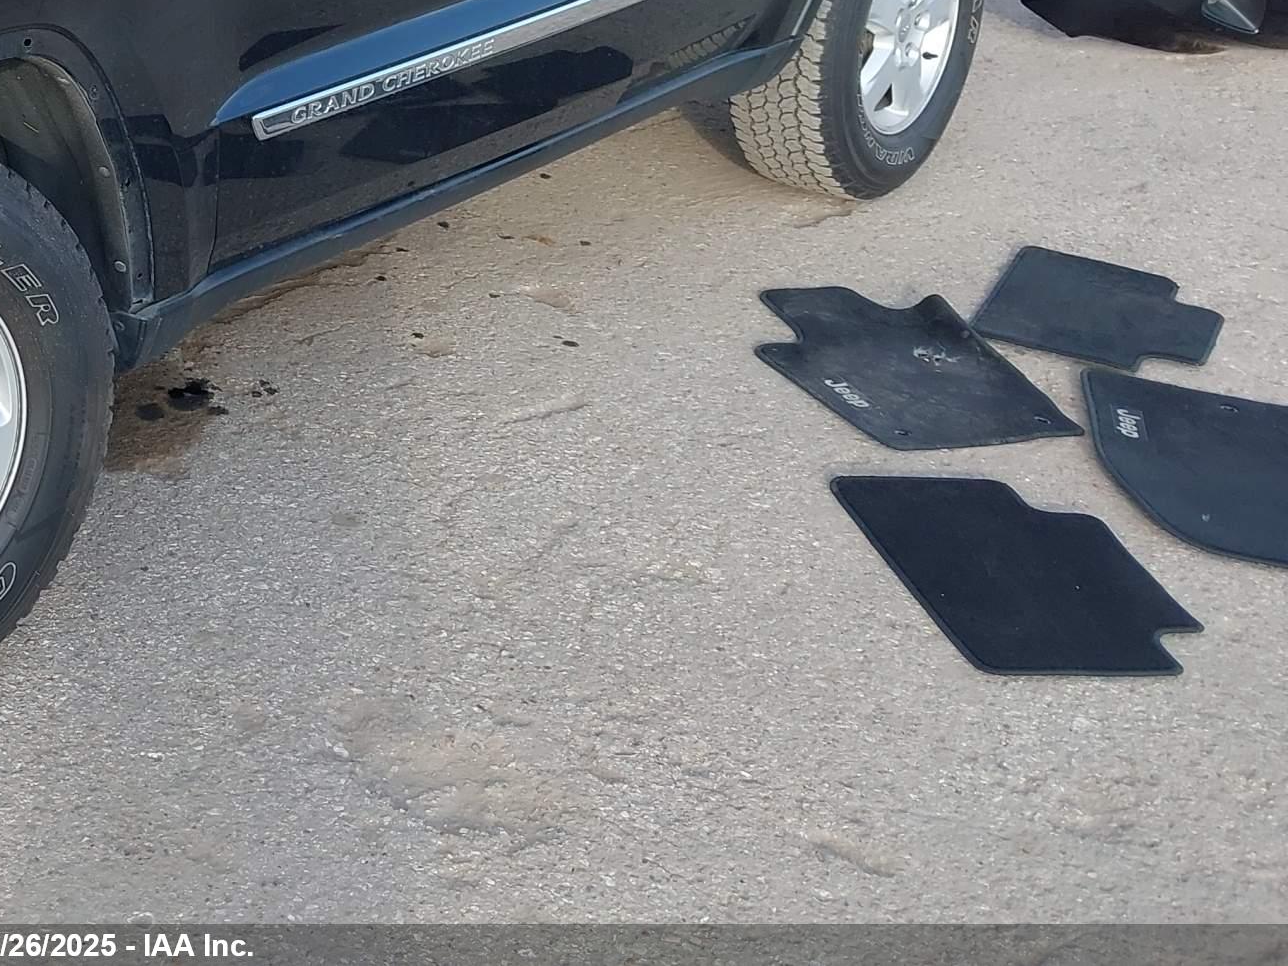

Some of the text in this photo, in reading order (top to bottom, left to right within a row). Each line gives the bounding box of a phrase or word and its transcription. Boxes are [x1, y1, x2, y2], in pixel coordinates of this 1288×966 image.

[290, 39, 495, 125] GRAND CHEROKEE
[823, 379, 870, 408] Jeep
[1115, 408, 1142, 439] Jeep
